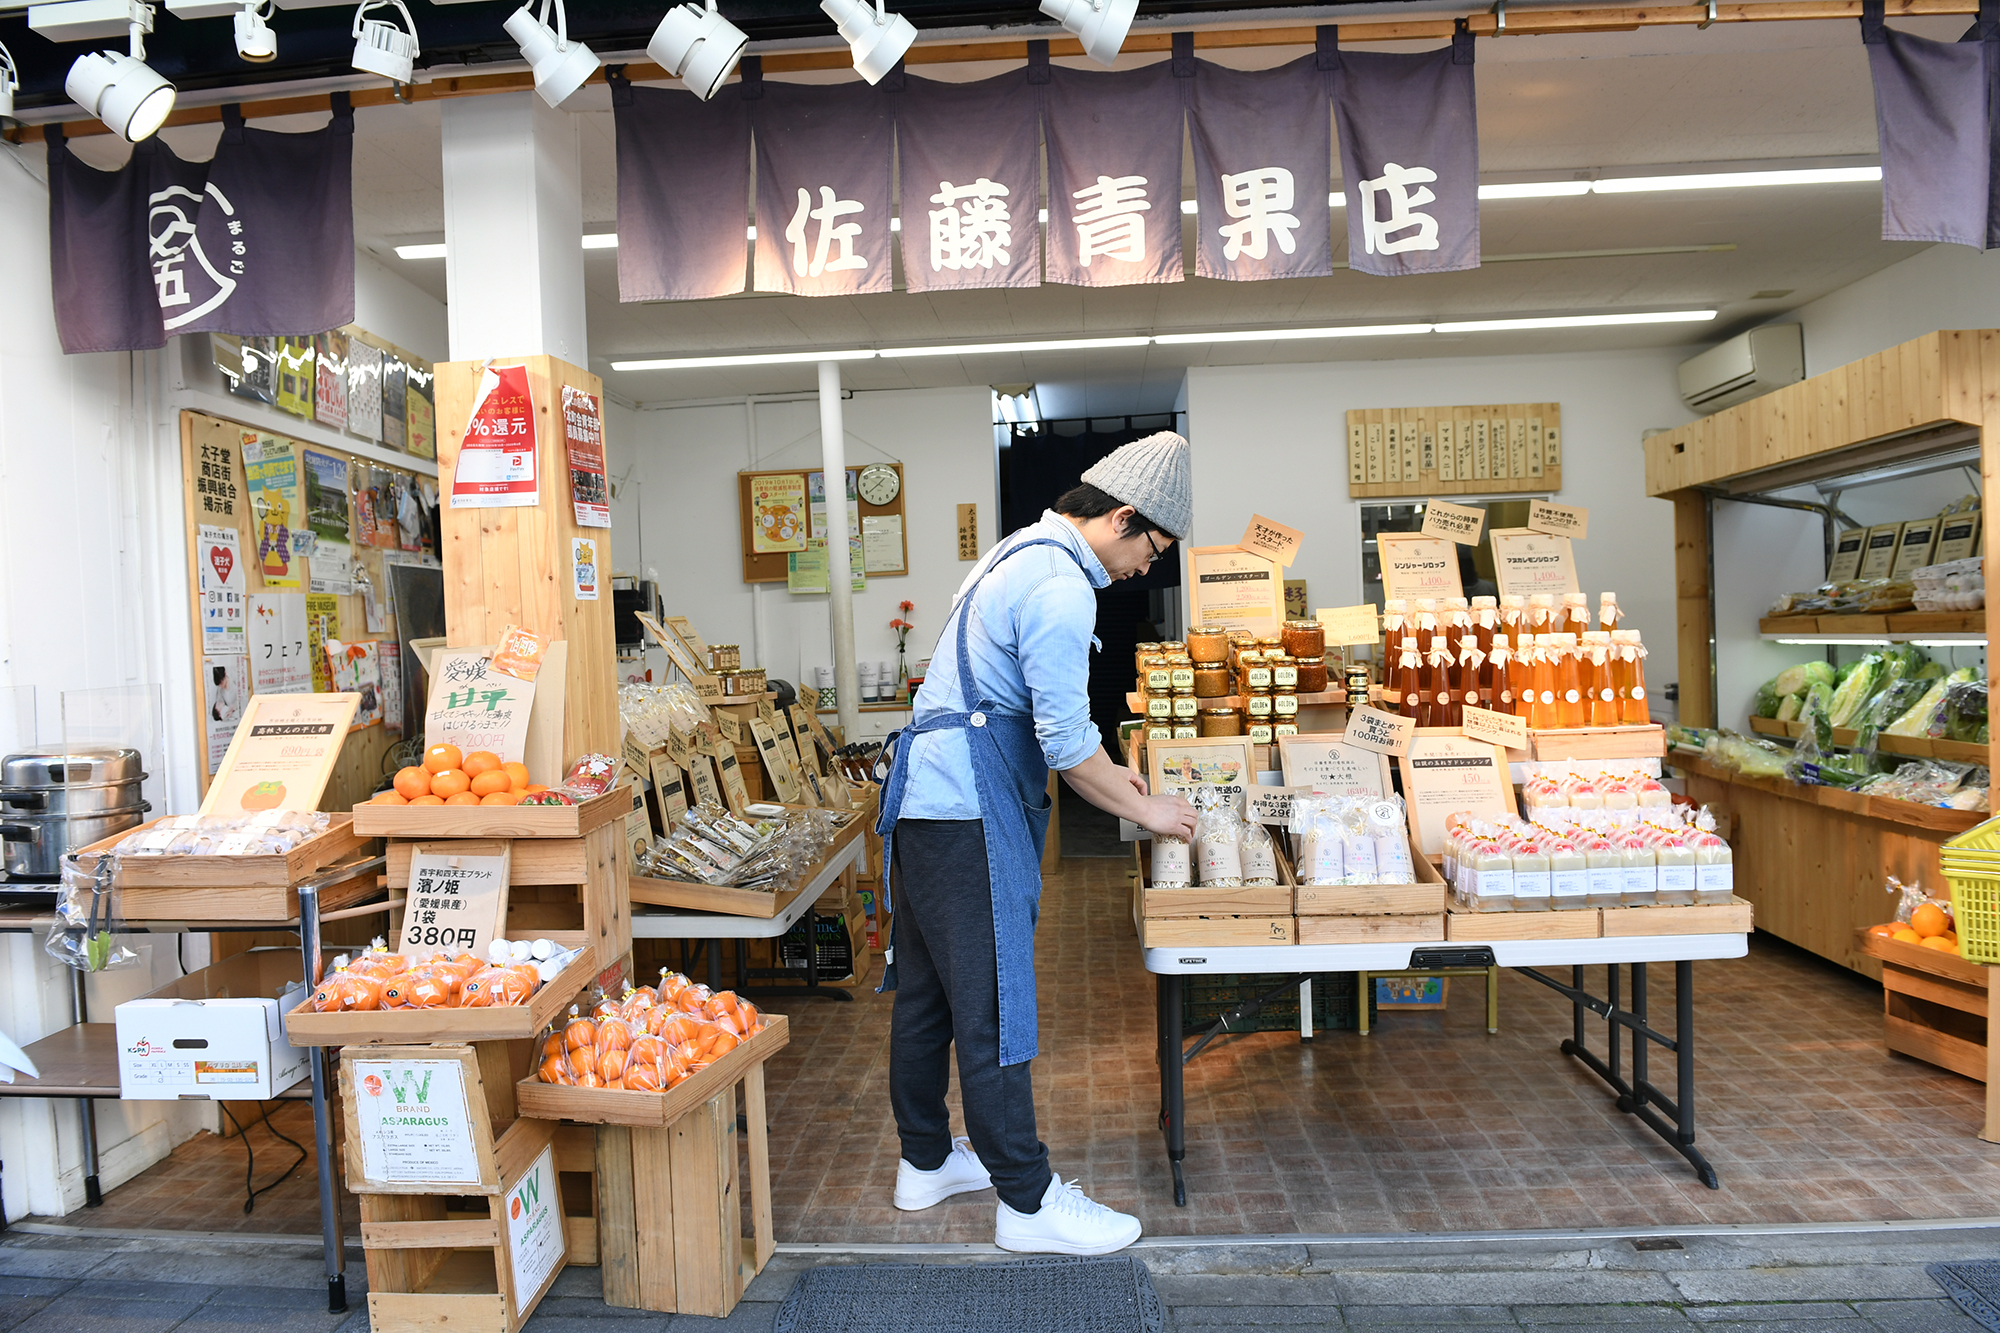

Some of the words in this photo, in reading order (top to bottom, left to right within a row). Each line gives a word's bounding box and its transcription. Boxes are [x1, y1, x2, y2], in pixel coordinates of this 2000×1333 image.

[785, 161, 1440, 278] 佐藤青果店
[227, 220, 246, 275] まるご
[477, 406, 526, 416] いのお客様に
[201, 443, 231, 465] 太子堂
[1442, 428, 1450, 477] マヌカハニー
[201, 461, 231, 482] 商店街
[197, 476, 237, 500] 振興組合
[203, 495, 233, 516] 掲示板
[1539, 507, 1576, 519] 砂糖不使用。
[1429, 516, 1474, 532] バカ売れ必至。
[1430, 508, 1478, 524] これからの時期
[1533, 512, 1580, 527] はちみつの甘さ。
[1255, 523, 1293, 544] 天才が作った
[1394, 561, 1446, 569] ジンジャーシロップ
[1506, 555, 1560, 563] マヌカレモンシロップ
[306, 601, 317, 611] FIRE
[444, 657, 488, 684] 愛媛
[1150, 674, 1167, 682] GOLDEN
[1174, 673, 1190, 681] GOLDEN
[1360, 713, 1403, 732] 3袋まとめて
[1369, 726, 1390, 737] 買うと
[466, 733, 505, 747] 200円
[1415, 759, 1490, 767] 伝説の玉ねぎドレッシング
[419, 868, 492, 878] 西宇和四天王ブランド
[417, 878, 460, 895] 濱ノ姫
[413, 910, 436, 924] 1袋
[407, 926, 476, 949] 380円
[383, 1070, 433, 1104] W
[396, 1105, 430, 1113] BRAND
[382, 1117, 449, 1127] ASPARAGUS
[518, 1166, 540, 1216] W
[520, 1205, 548, 1248] ASPARAGUS
